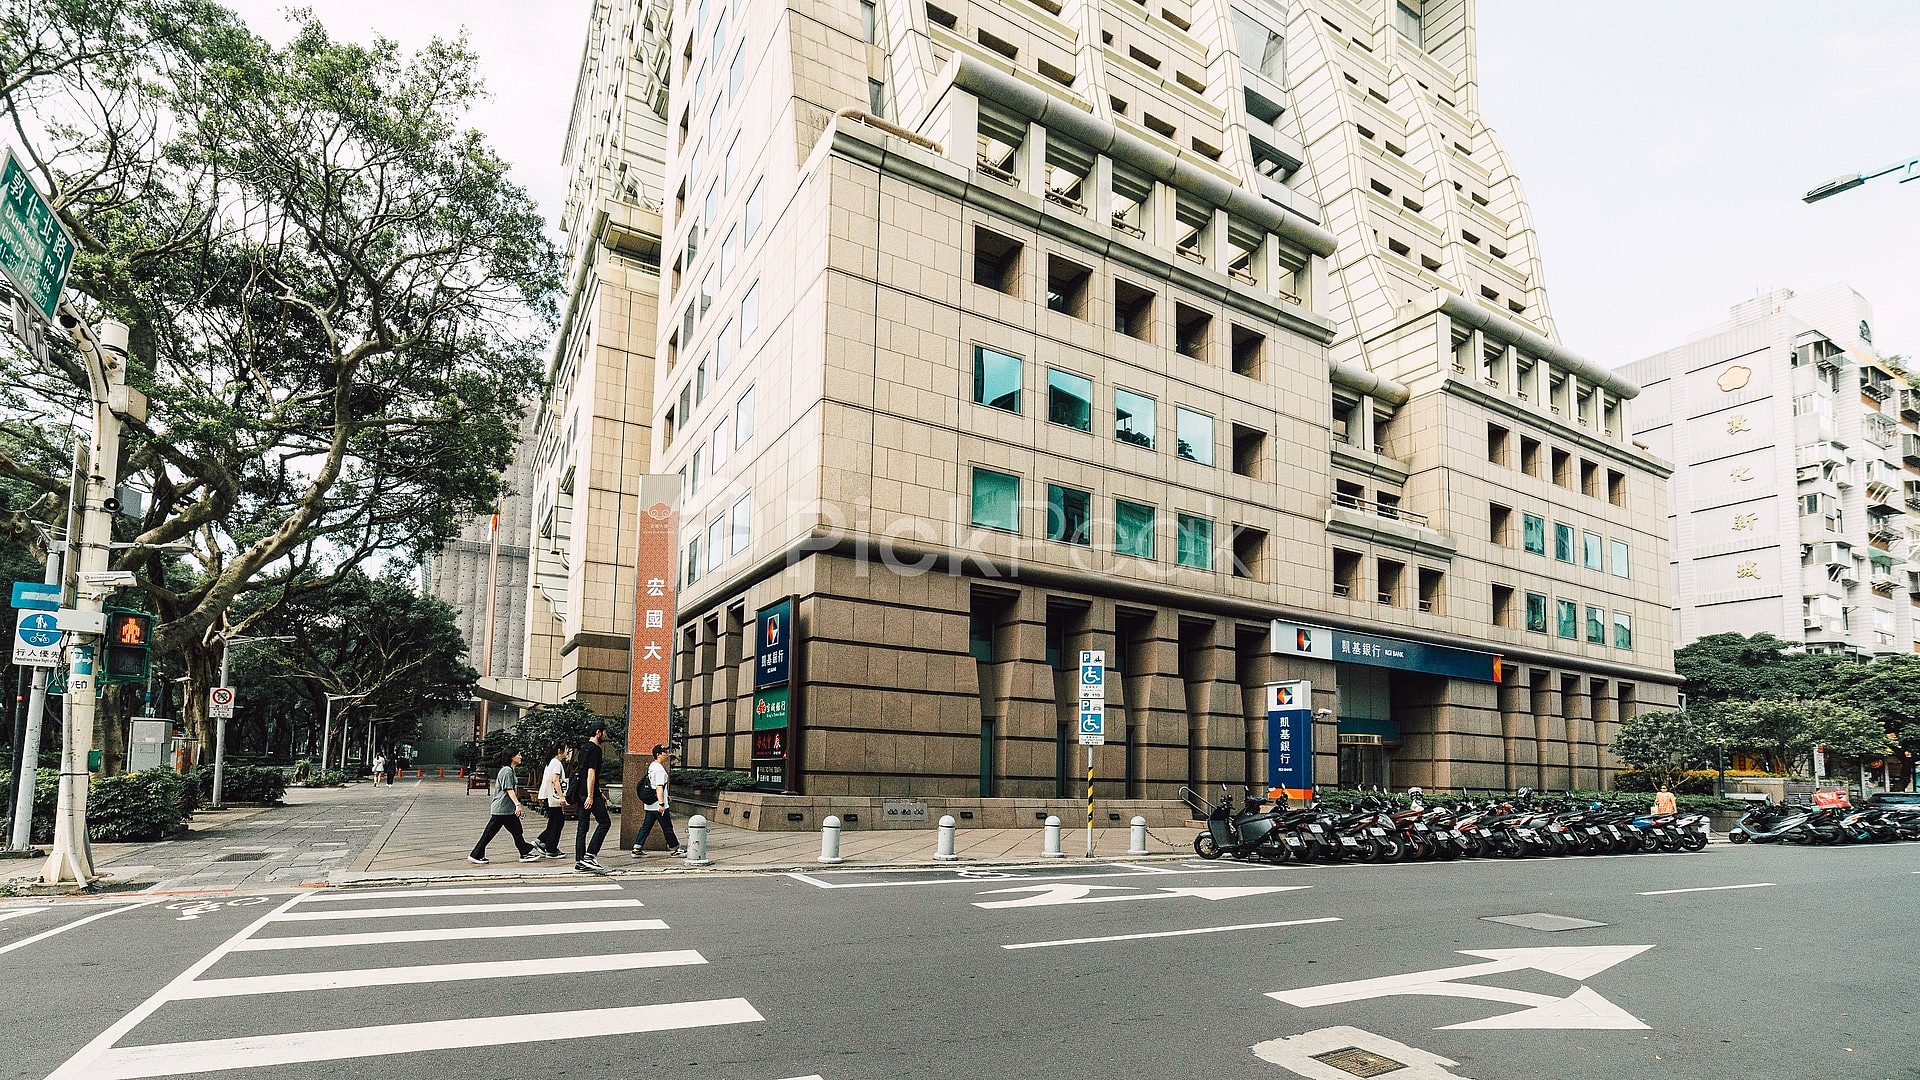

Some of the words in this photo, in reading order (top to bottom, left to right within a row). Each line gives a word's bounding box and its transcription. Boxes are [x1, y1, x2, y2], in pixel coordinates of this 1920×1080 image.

[6, 203, 36, 248] DunHua
[44, 255, 55, 277] Rd.
[10, 170, 67, 262] 敦化北路
[1727, 413, 1761, 580] 敦化新城
[16, 648, 60, 659] 行人優先
[641, 577, 665, 693] 宏國大樓
[1341, 639, 1381, 658] 凱基銀行
[1279, 716, 1291, 765] 凱基銀行
